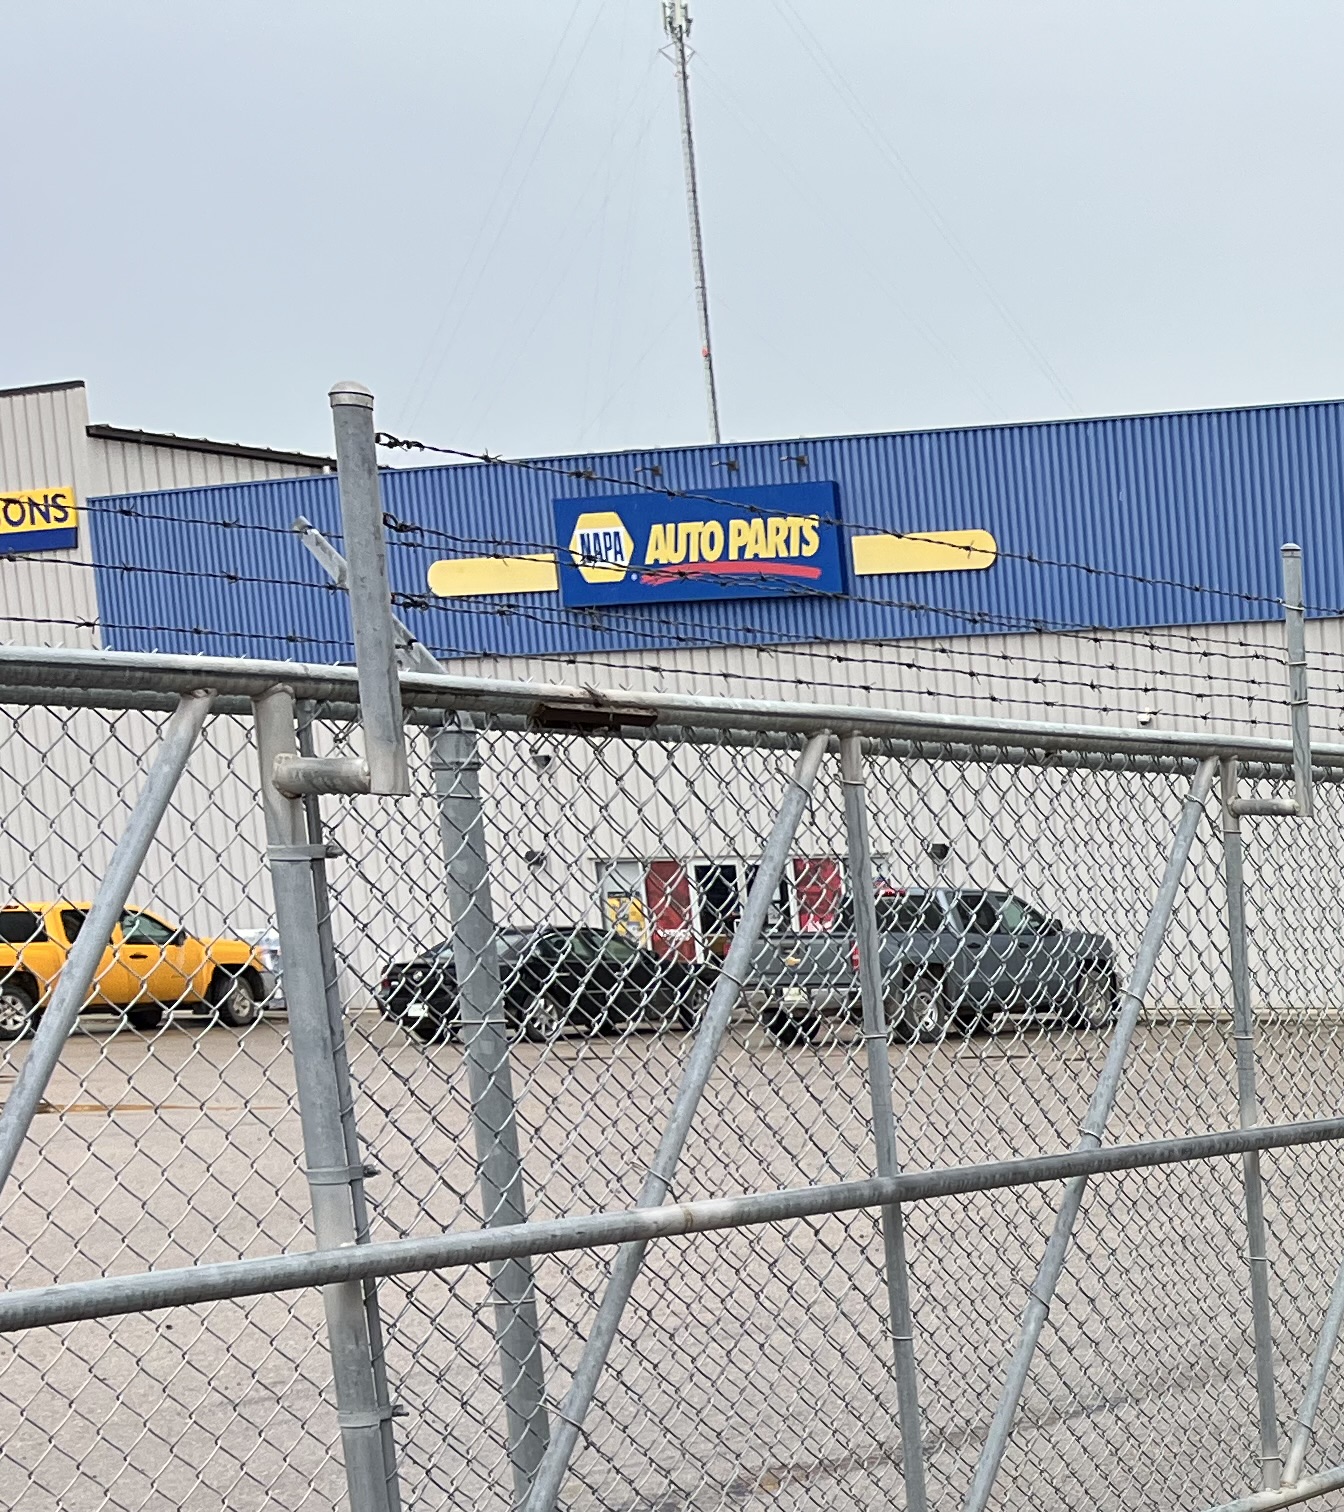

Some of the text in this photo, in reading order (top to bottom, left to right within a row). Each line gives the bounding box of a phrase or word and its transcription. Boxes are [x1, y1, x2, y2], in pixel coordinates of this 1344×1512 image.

[3, 494, 69, 527] ONS
[579, 531, 624, 563] NAPA
[645, 514, 820, 565] AUTO PARTS
